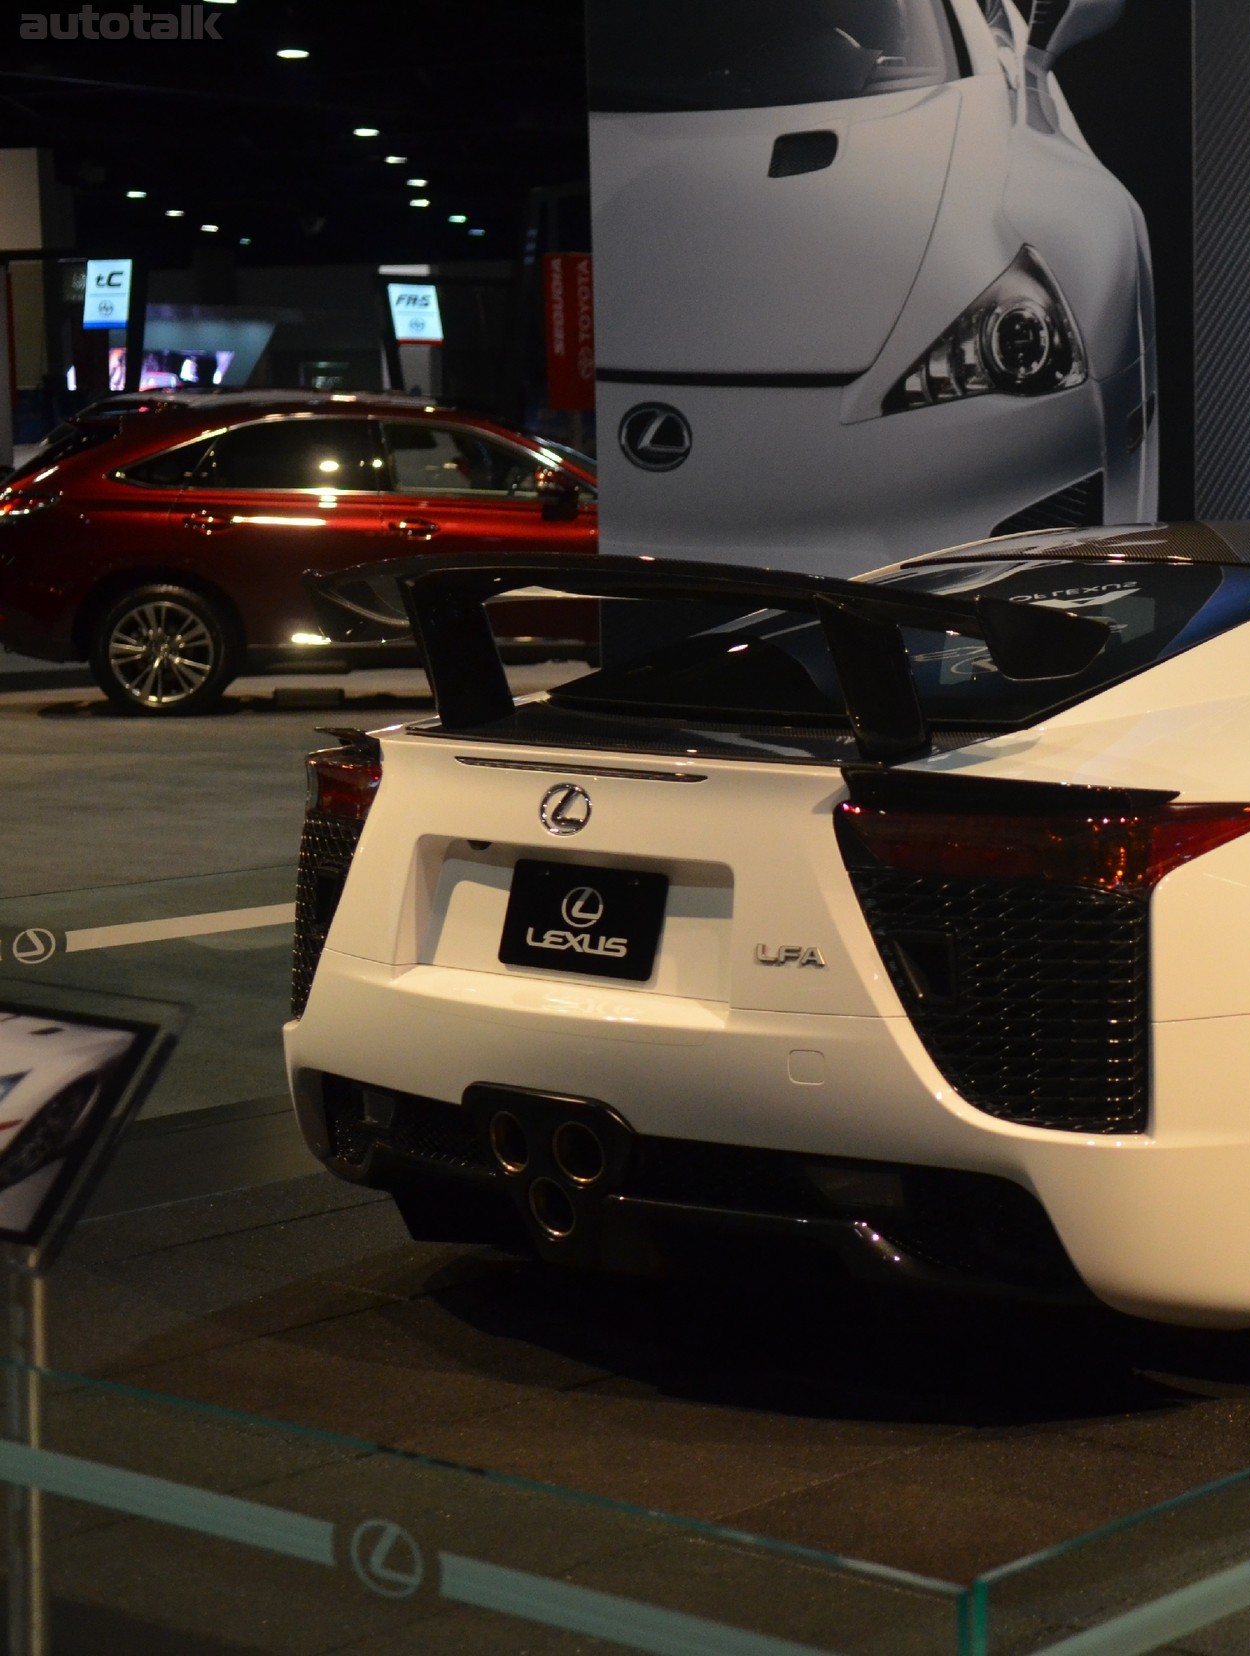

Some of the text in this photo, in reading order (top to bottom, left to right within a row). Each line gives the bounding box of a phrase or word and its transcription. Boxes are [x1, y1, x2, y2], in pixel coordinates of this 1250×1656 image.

[95, 270, 124, 287] tC
[577, 258, 591, 343] TOYOTA
[526, 926, 628, 958] LEXUS
[756, 943, 826, 967] LFA
